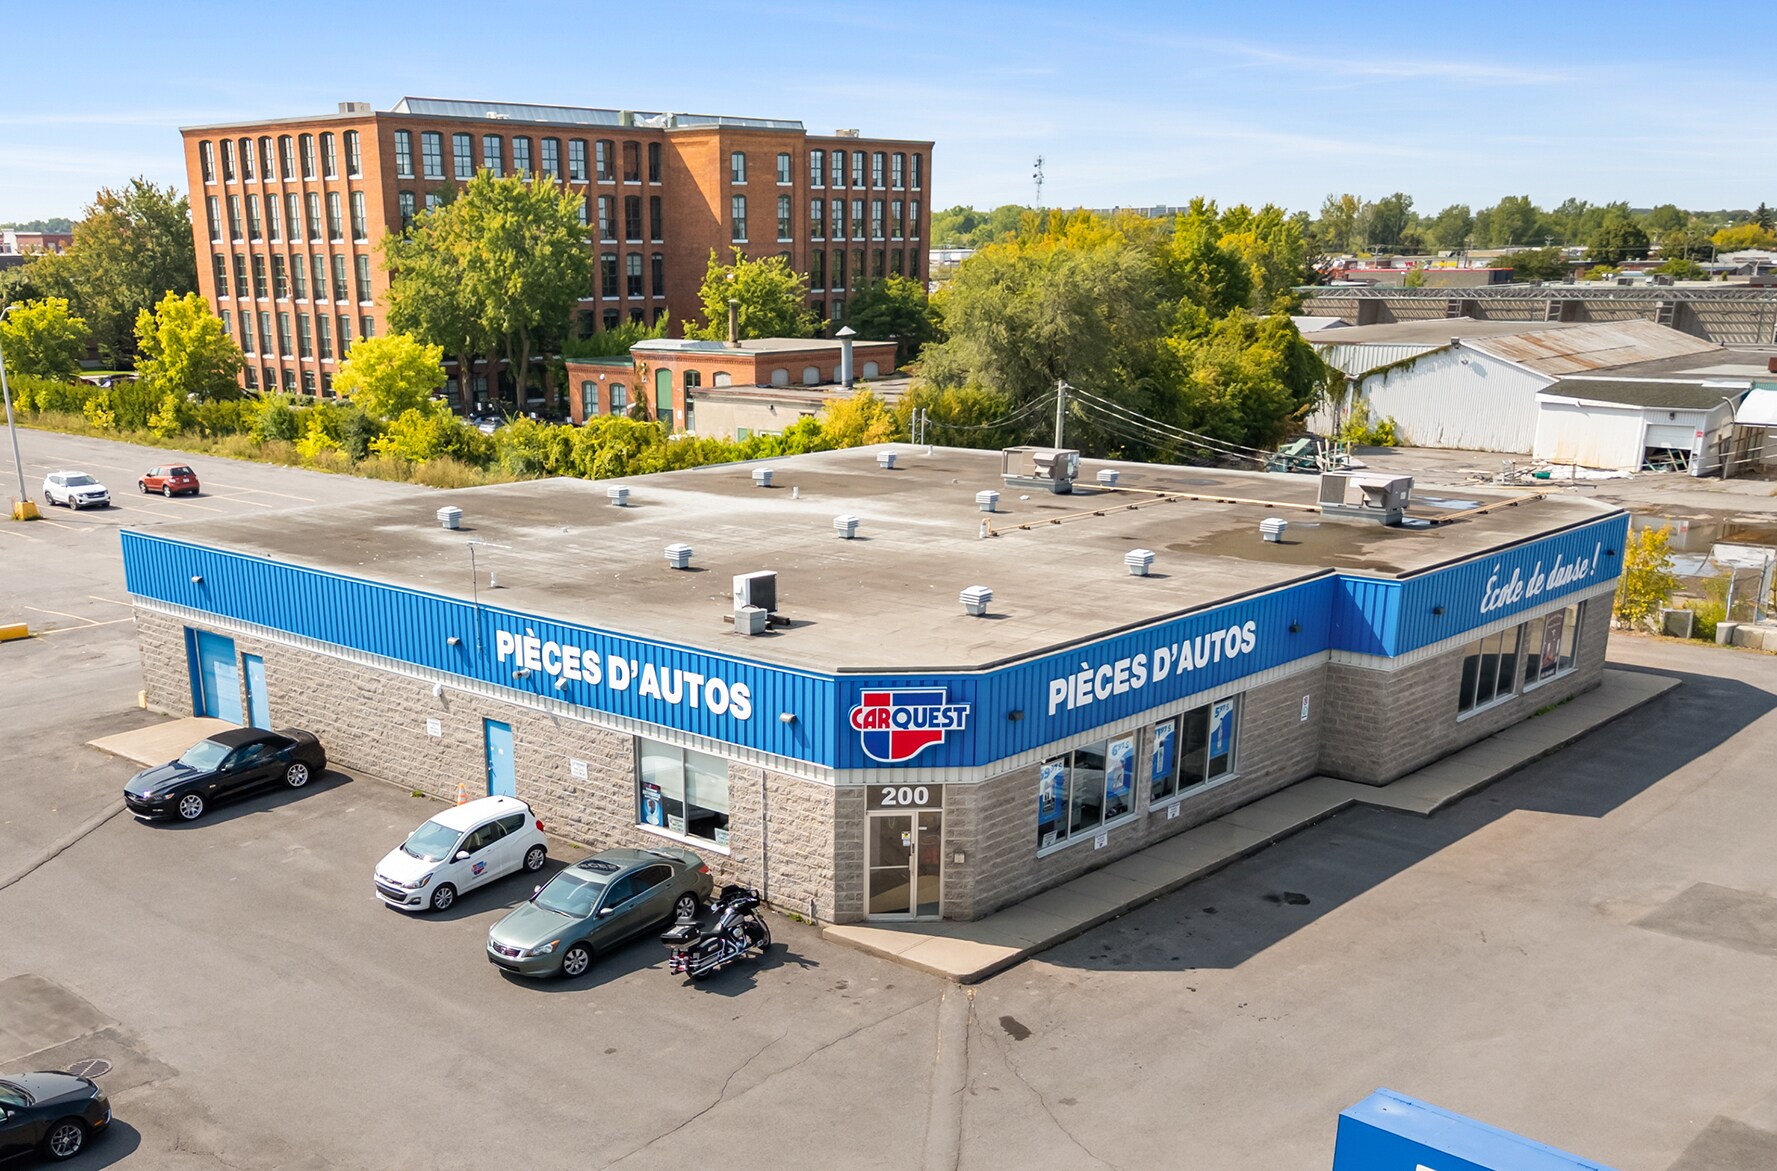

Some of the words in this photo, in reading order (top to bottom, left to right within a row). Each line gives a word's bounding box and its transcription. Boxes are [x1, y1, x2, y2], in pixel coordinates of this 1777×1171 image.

[1480, 563, 1523, 613] École
[1525, 561, 1545, 598] de
[1546, 554, 1589, 591] danse
[496, 628, 602, 685] PIÈCES
[607, 654, 752, 720] D'AUTOS
[1048, 653, 1148, 716] PIÈCES
[1152, 620, 1256, 682] D'AUTOS
[851, 706, 968, 730] CARQUEST
[881, 786, 929, 806] 200
